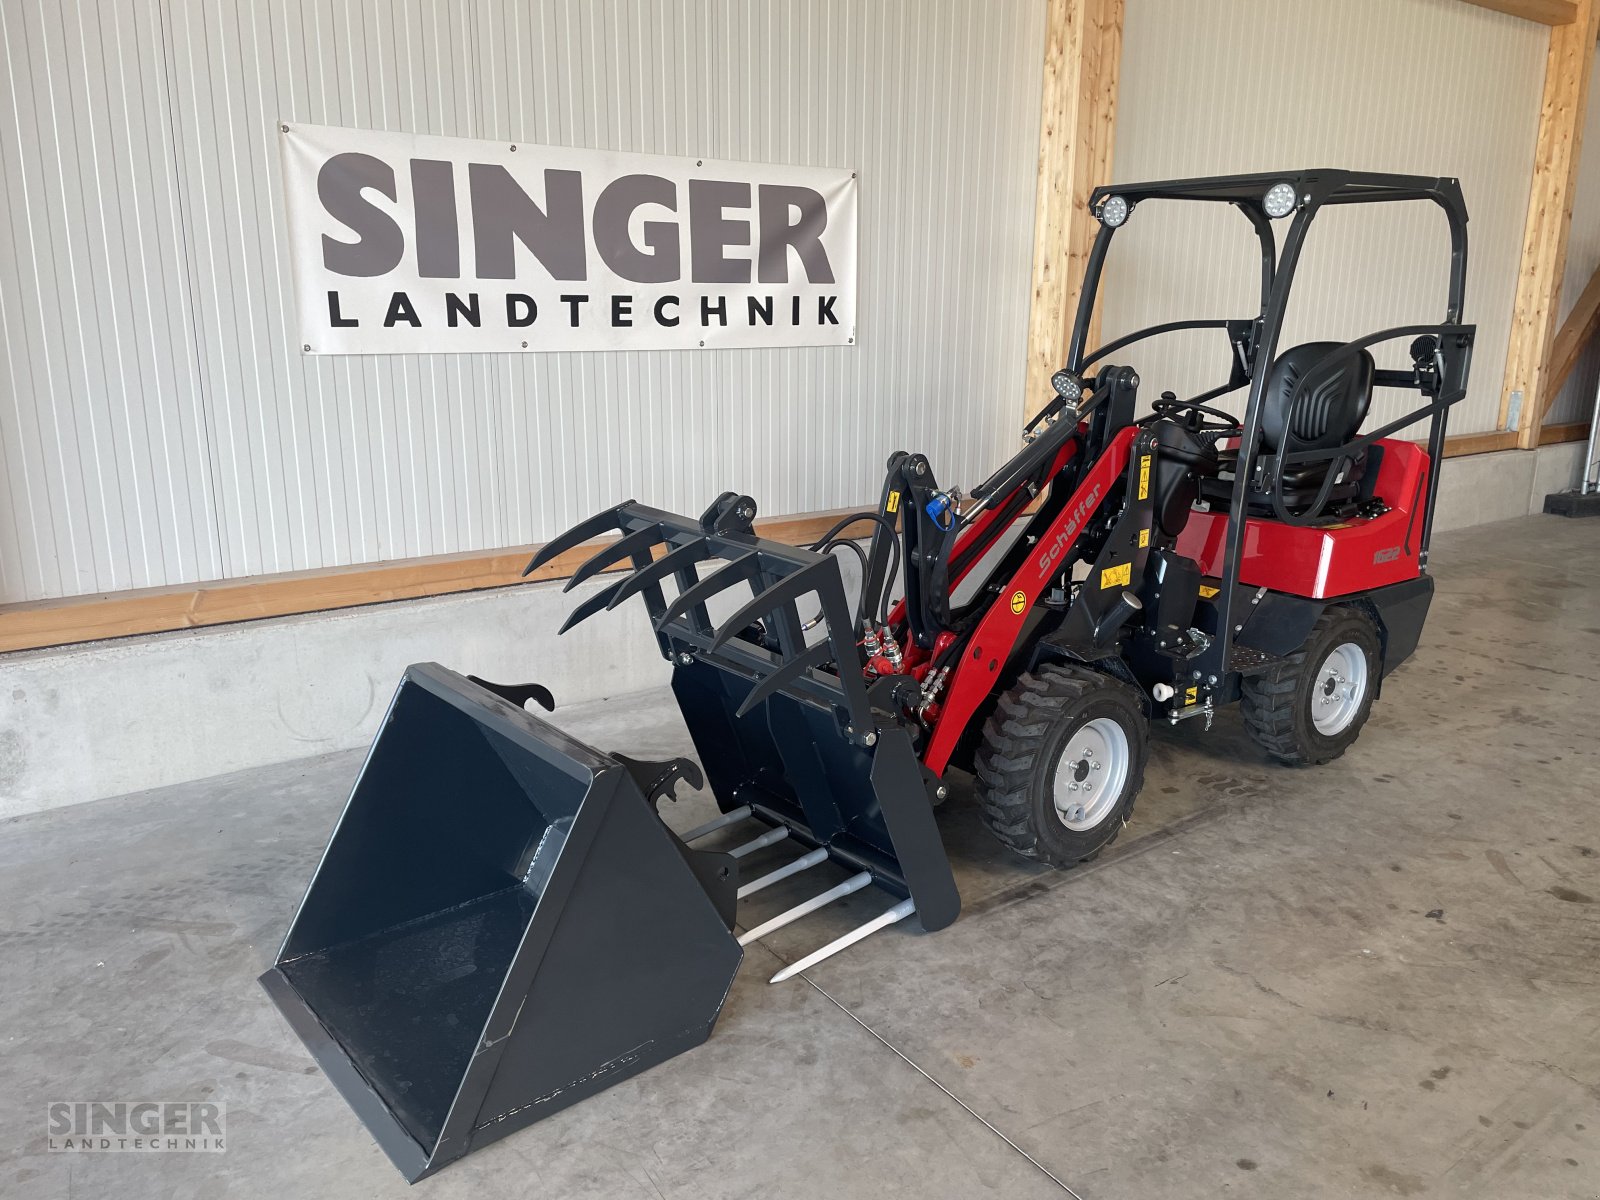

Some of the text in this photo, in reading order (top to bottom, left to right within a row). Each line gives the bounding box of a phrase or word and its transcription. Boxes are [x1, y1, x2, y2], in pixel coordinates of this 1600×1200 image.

[317, 152, 835, 284] SINGER
[327, 290, 839, 327] LANDTECHNIK
[1038, 483, 1101, 579] Schäffer
